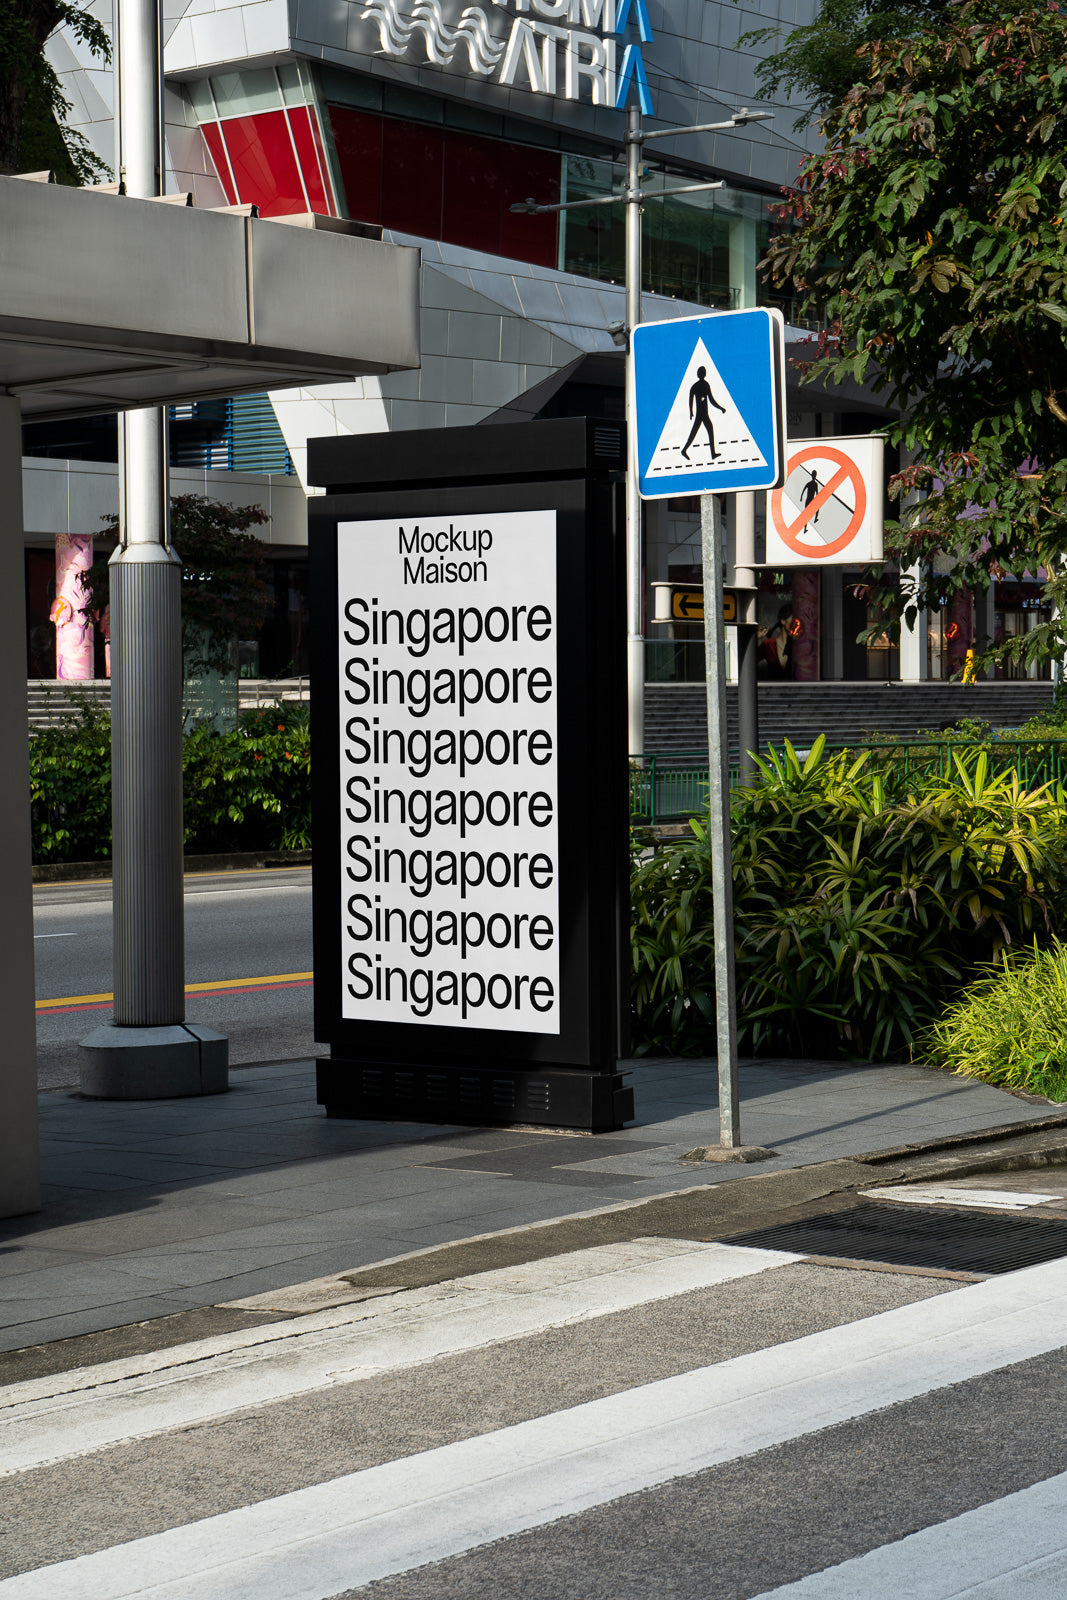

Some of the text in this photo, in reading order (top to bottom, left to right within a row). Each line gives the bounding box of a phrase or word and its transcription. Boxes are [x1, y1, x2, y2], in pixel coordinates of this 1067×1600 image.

[398, 523, 493, 557] Mockup
[403, 555, 488, 585] Maison
[343, 597, 552, 657] Singapore
[344, 657, 553, 717] Singapore
[344, 716, 554, 778] Singapore
[345, 775, 554, 839] Singapore
[345, 834, 554, 899] Singapore
[346, 893, 555, 960] Singapore
[347, 952, 555, 1020] Singapore
